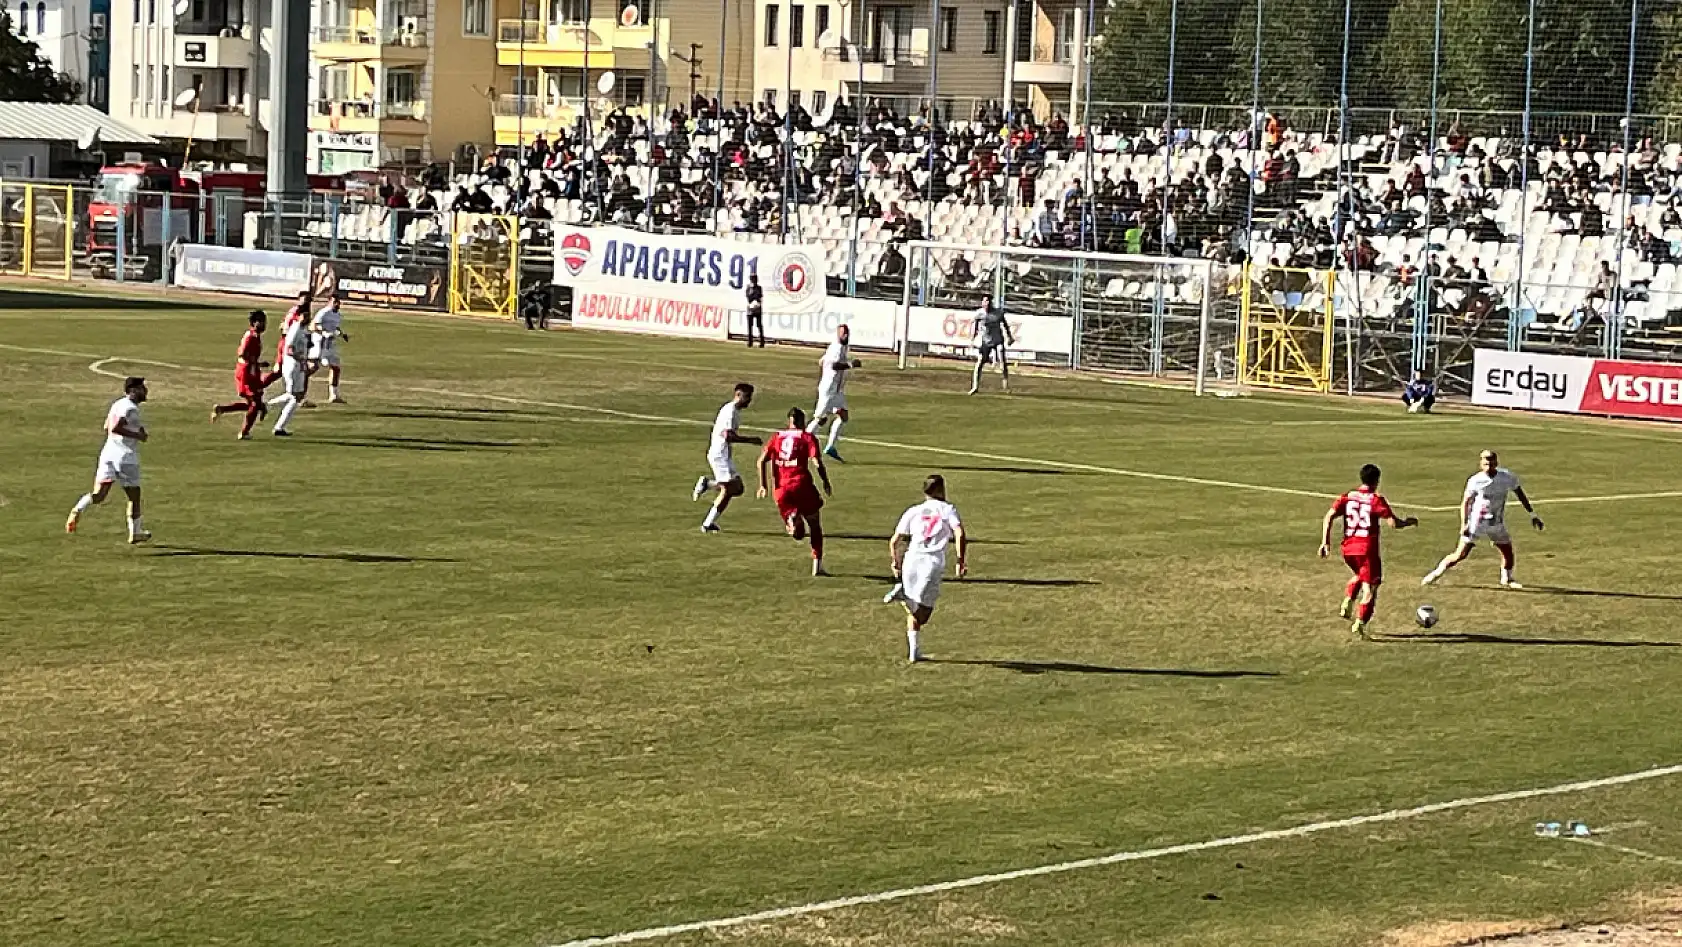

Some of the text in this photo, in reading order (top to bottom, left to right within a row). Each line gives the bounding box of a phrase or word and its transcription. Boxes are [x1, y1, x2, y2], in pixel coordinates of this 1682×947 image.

[601, 239, 722, 287] APACHES
[728, 254, 759, 290] 91
[578, 293, 723, 329] ABDULLAH KOYUNCU
[1486, 364, 1567, 399] erday
[779, 435, 795, 461] 9
[922, 515, 942, 540] 7
[1346, 500, 1372, 528] 55
